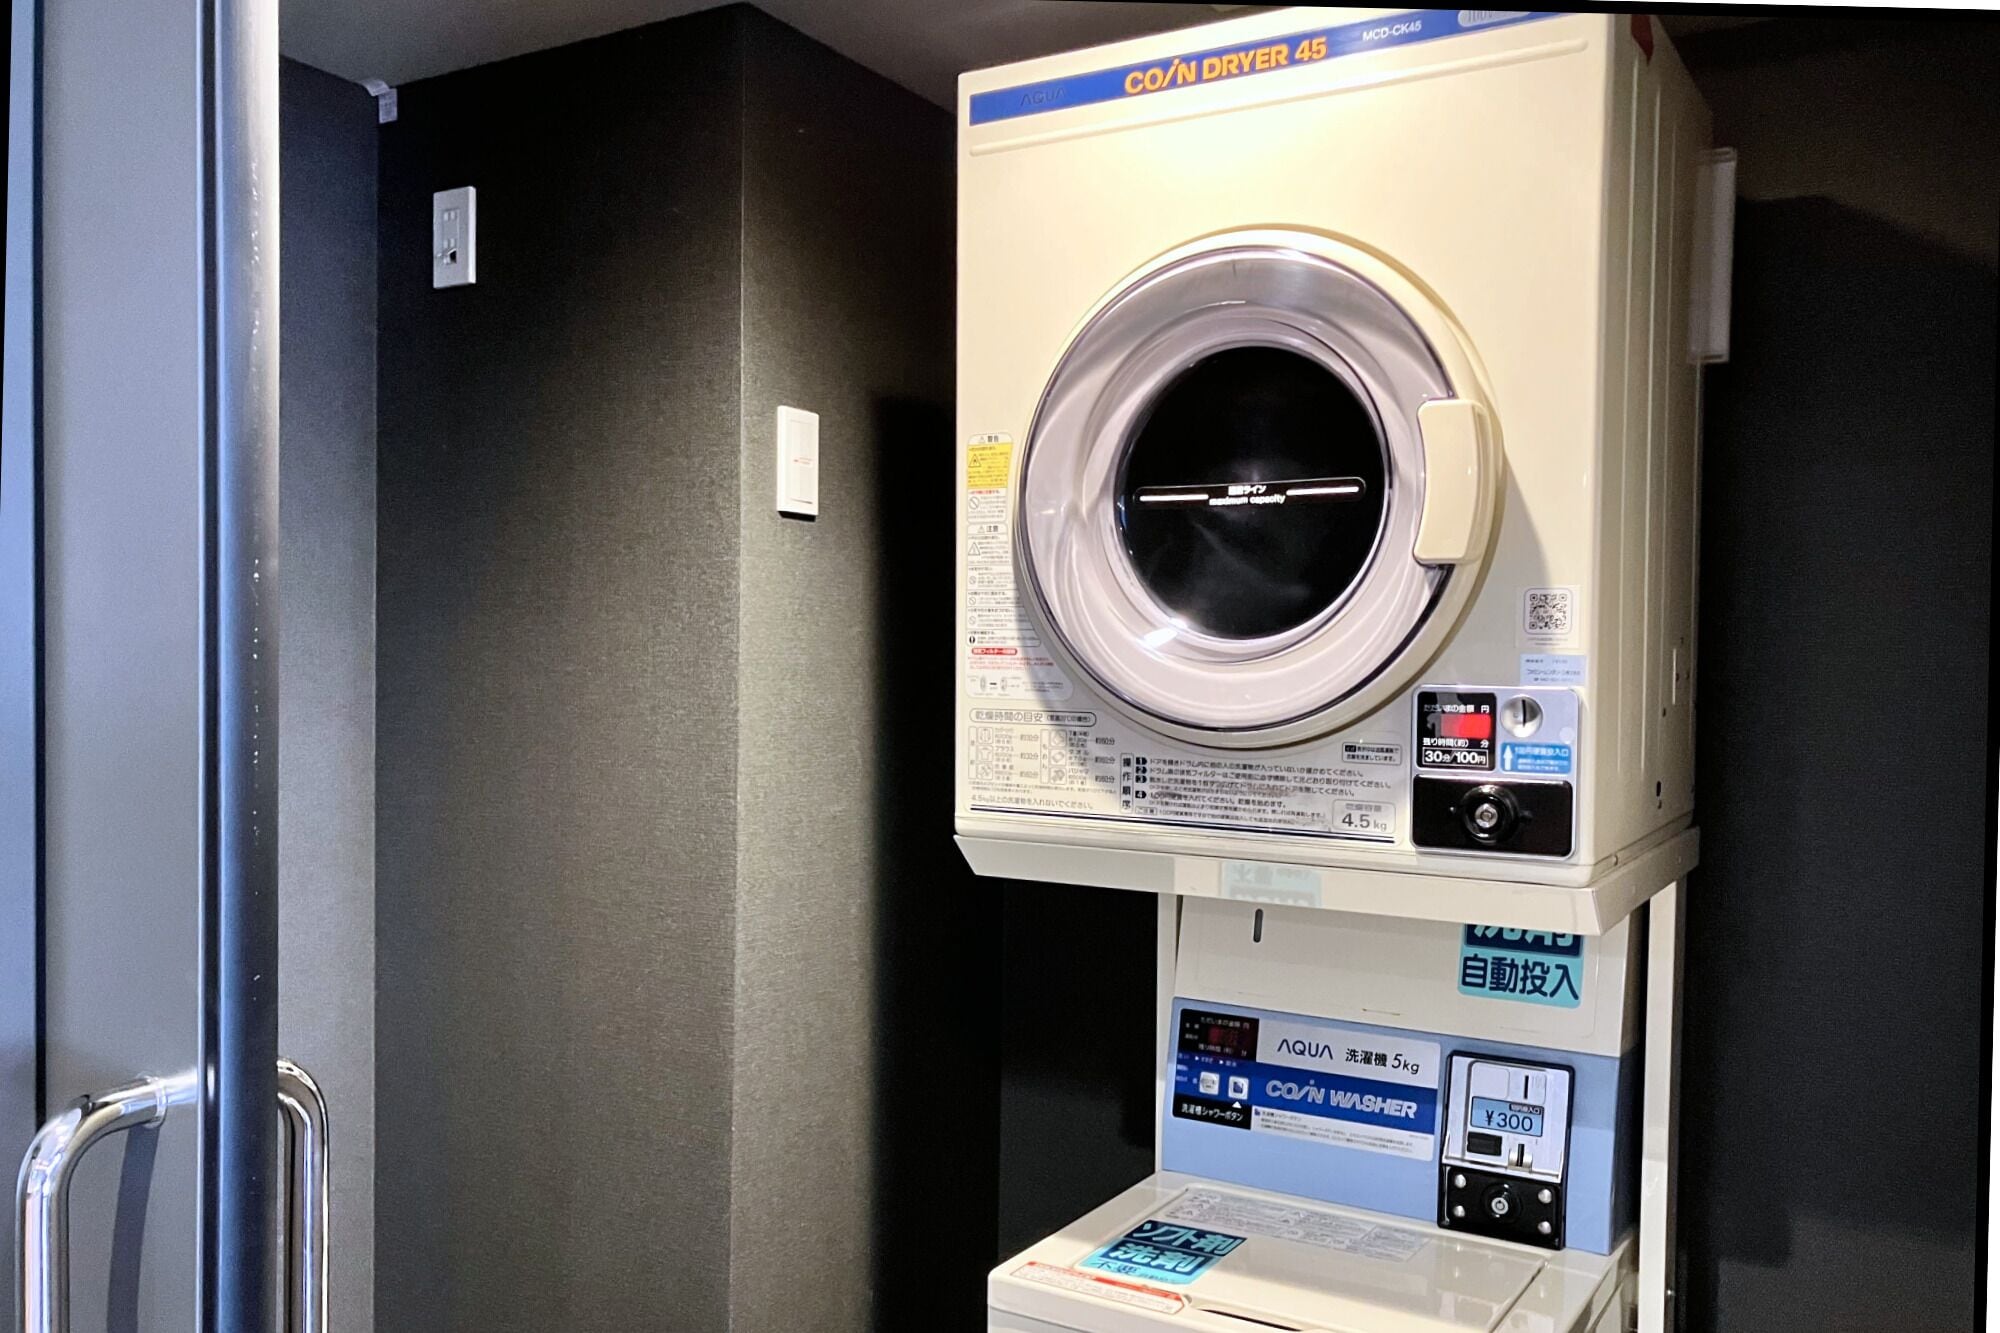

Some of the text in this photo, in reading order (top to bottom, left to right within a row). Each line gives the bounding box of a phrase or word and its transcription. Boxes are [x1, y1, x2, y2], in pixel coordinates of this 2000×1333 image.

[1362, 20, 1422, 41] MCD-CK45
[1202, 43, 1289, 81] DRYER
[1295, 36, 1327, 61] 45
[1020, 87, 1066, 107] AQUA
[1208, 493, 1287, 506] maximum capacity
[1228, 485, 1267, 496] ライン
[975, 711, 1043, 722] 乾燥時間の目安
[1481, 705, 1490, 713] 円
[1480, 740, 1489, 748] 分
[1424, 750, 1487, 764] 30分/100円
[1341, 812, 1371, 829] 4.5
[1373, 819, 1387, 831] kg
[1461, 953, 1580, 1001] 自動投入
[1277, 1038, 1334, 1061] AQUA
[1345, 1048, 1420, 1075] 洗濯機 5kg
[1330, 1089, 1417, 1120] WASHER
[1486, 1109, 1533, 1132] ¥300
[1132, 1223, 1244, 1256] ソフト剤
[1109, 1243, 1205, 1273] 洗剤
